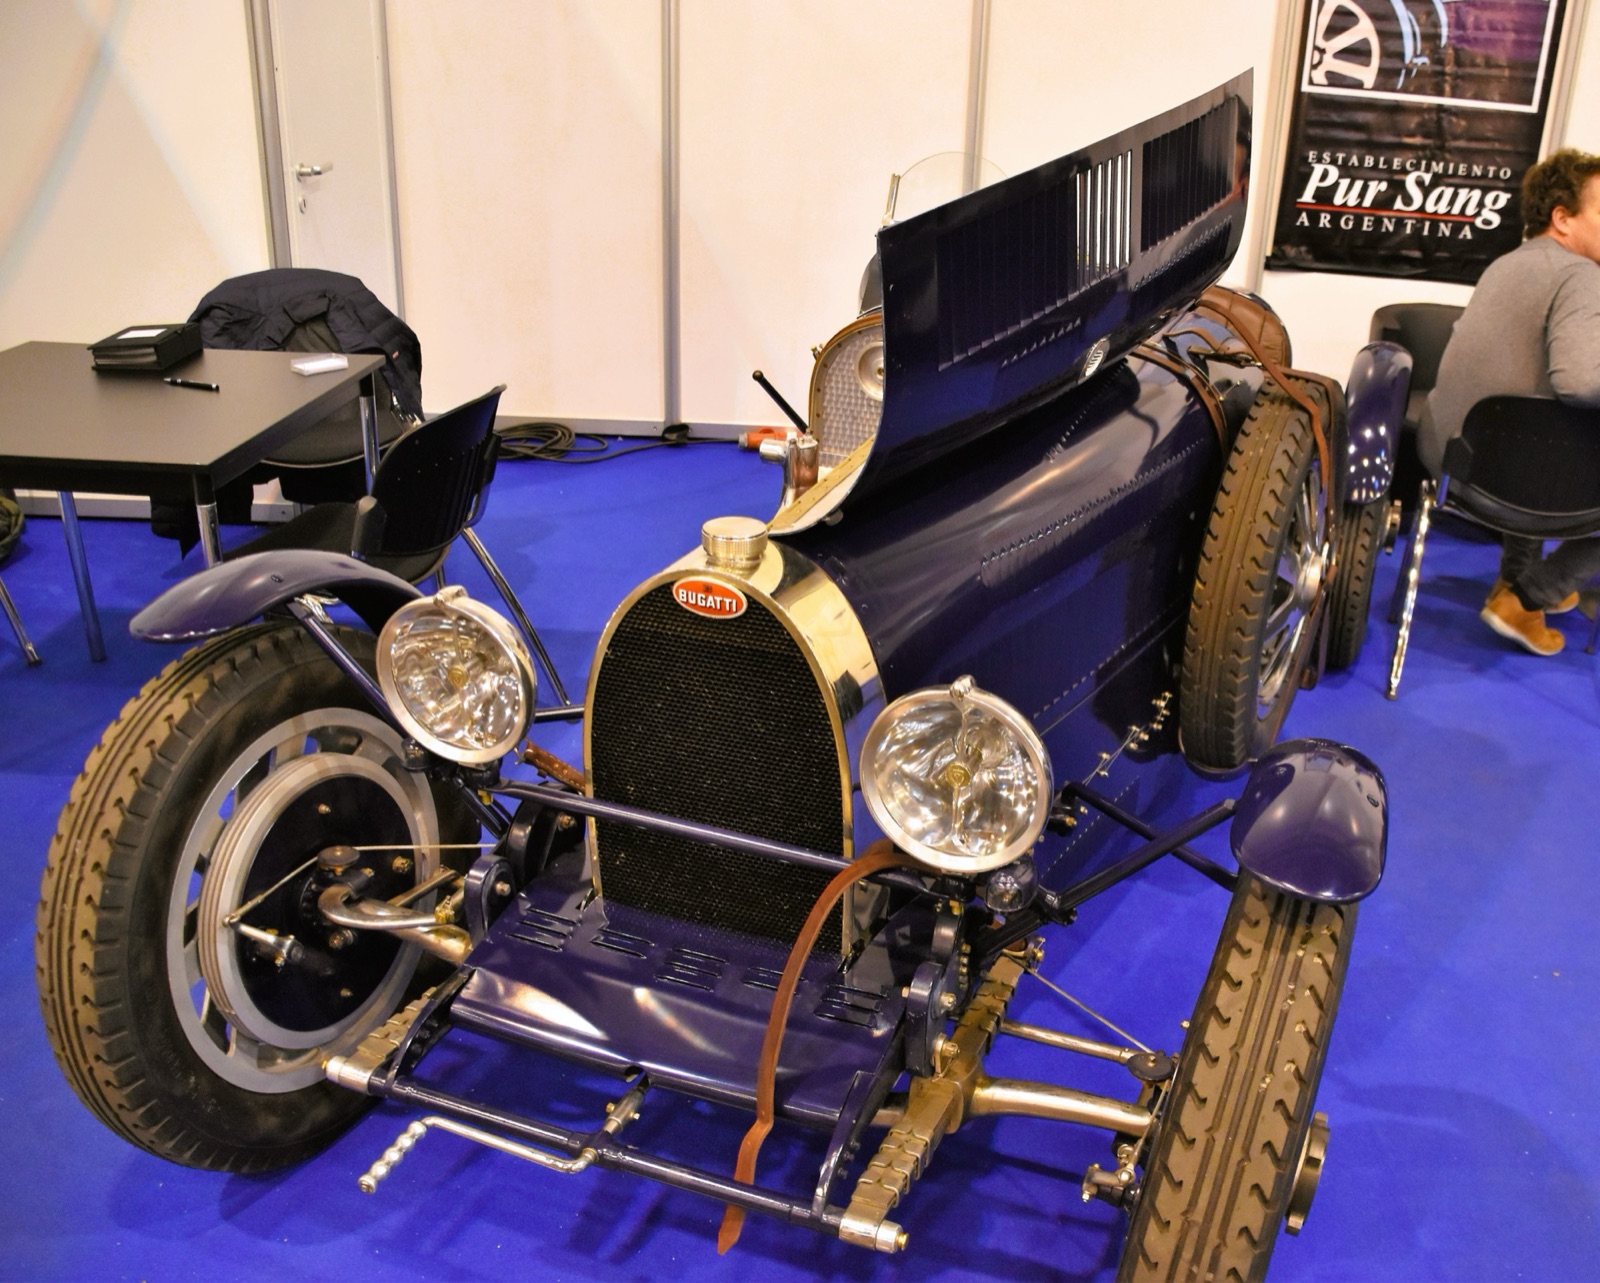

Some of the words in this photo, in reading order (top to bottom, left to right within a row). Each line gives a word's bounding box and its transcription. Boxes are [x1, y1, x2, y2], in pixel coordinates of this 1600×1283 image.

[1308, 151, 1511, 179] ESTABLECIMIENTO
[1297, 163, 1388, 208] Pur
[1394, 170, 1512, 230] Sang
[1296, 211, 1473, 239] ARGENTINA
[678, 588, 737, 612] BUGATTI
